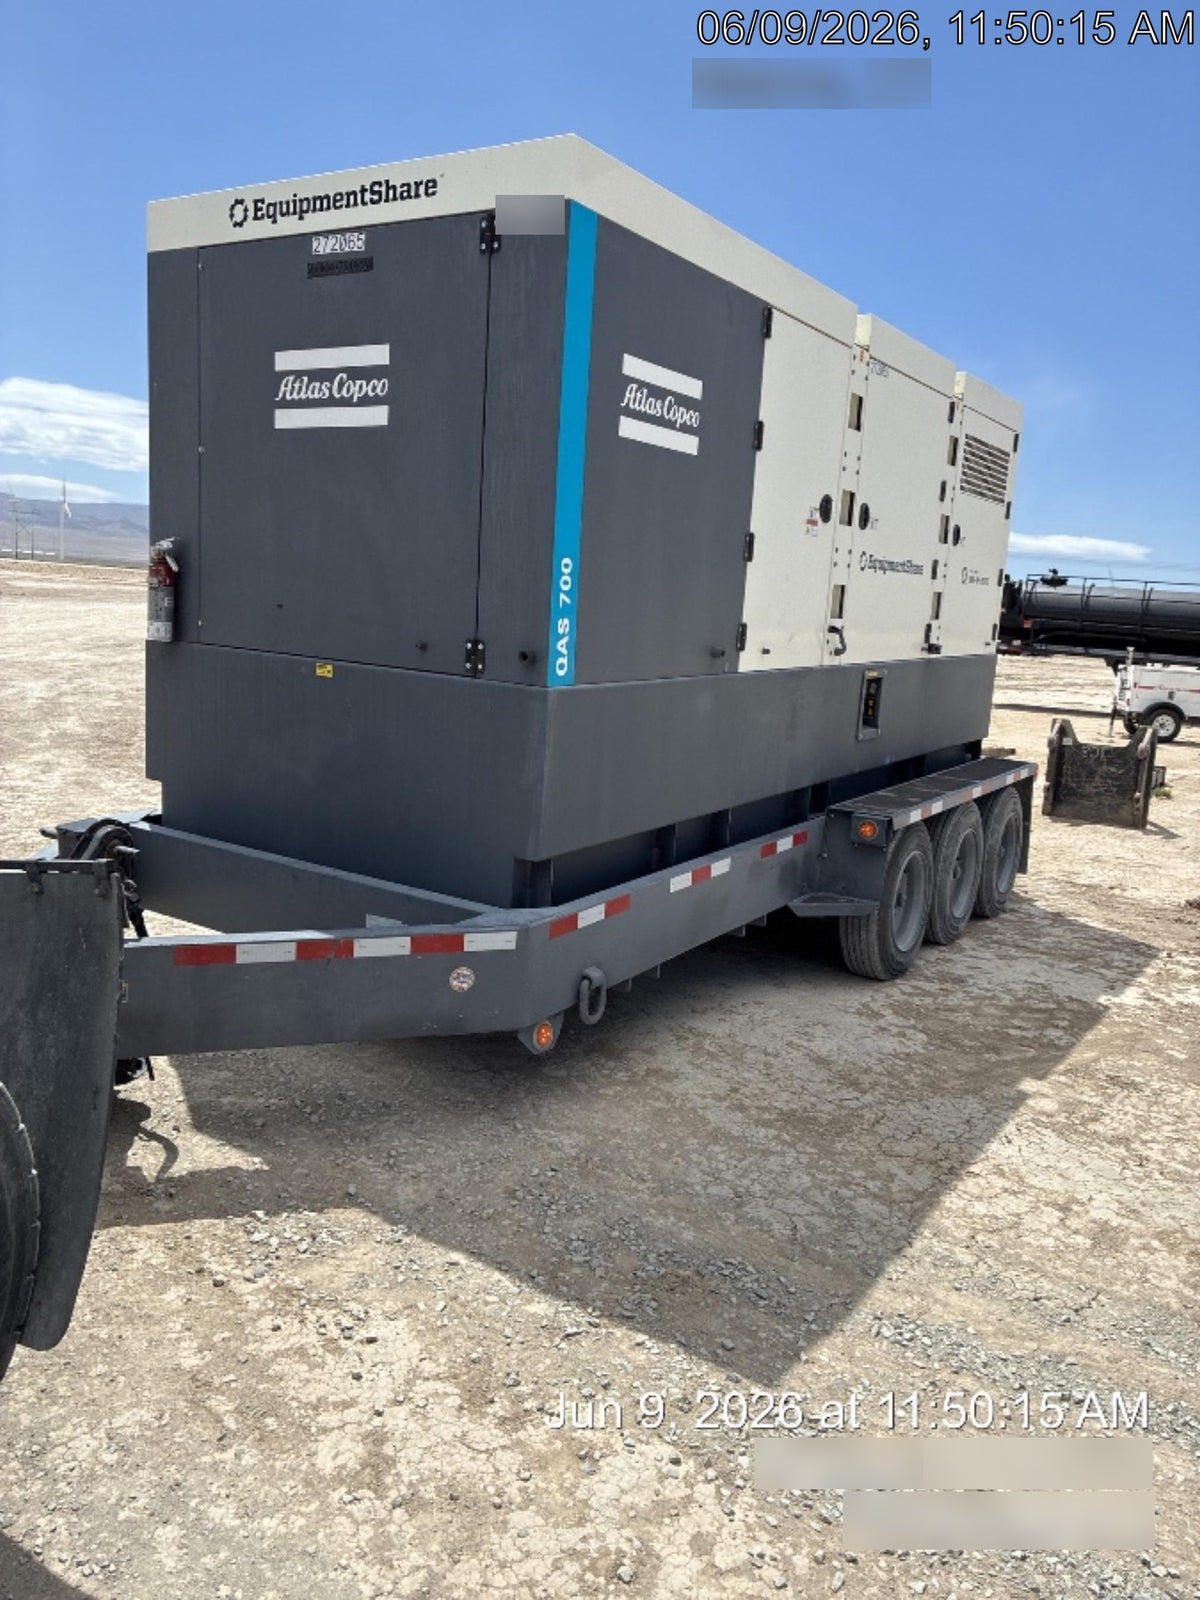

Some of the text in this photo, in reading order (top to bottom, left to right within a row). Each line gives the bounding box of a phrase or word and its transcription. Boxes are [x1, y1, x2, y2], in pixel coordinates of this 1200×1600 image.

[252, 178, 438, 224] EquipmentShare
[313, 232, 365, 253] 272065
[275, 373, 389, 402] Atlas Copco
[620, 383, 700, 428] Atlas Copco
[556, 557, 573, 677] QAS 700
